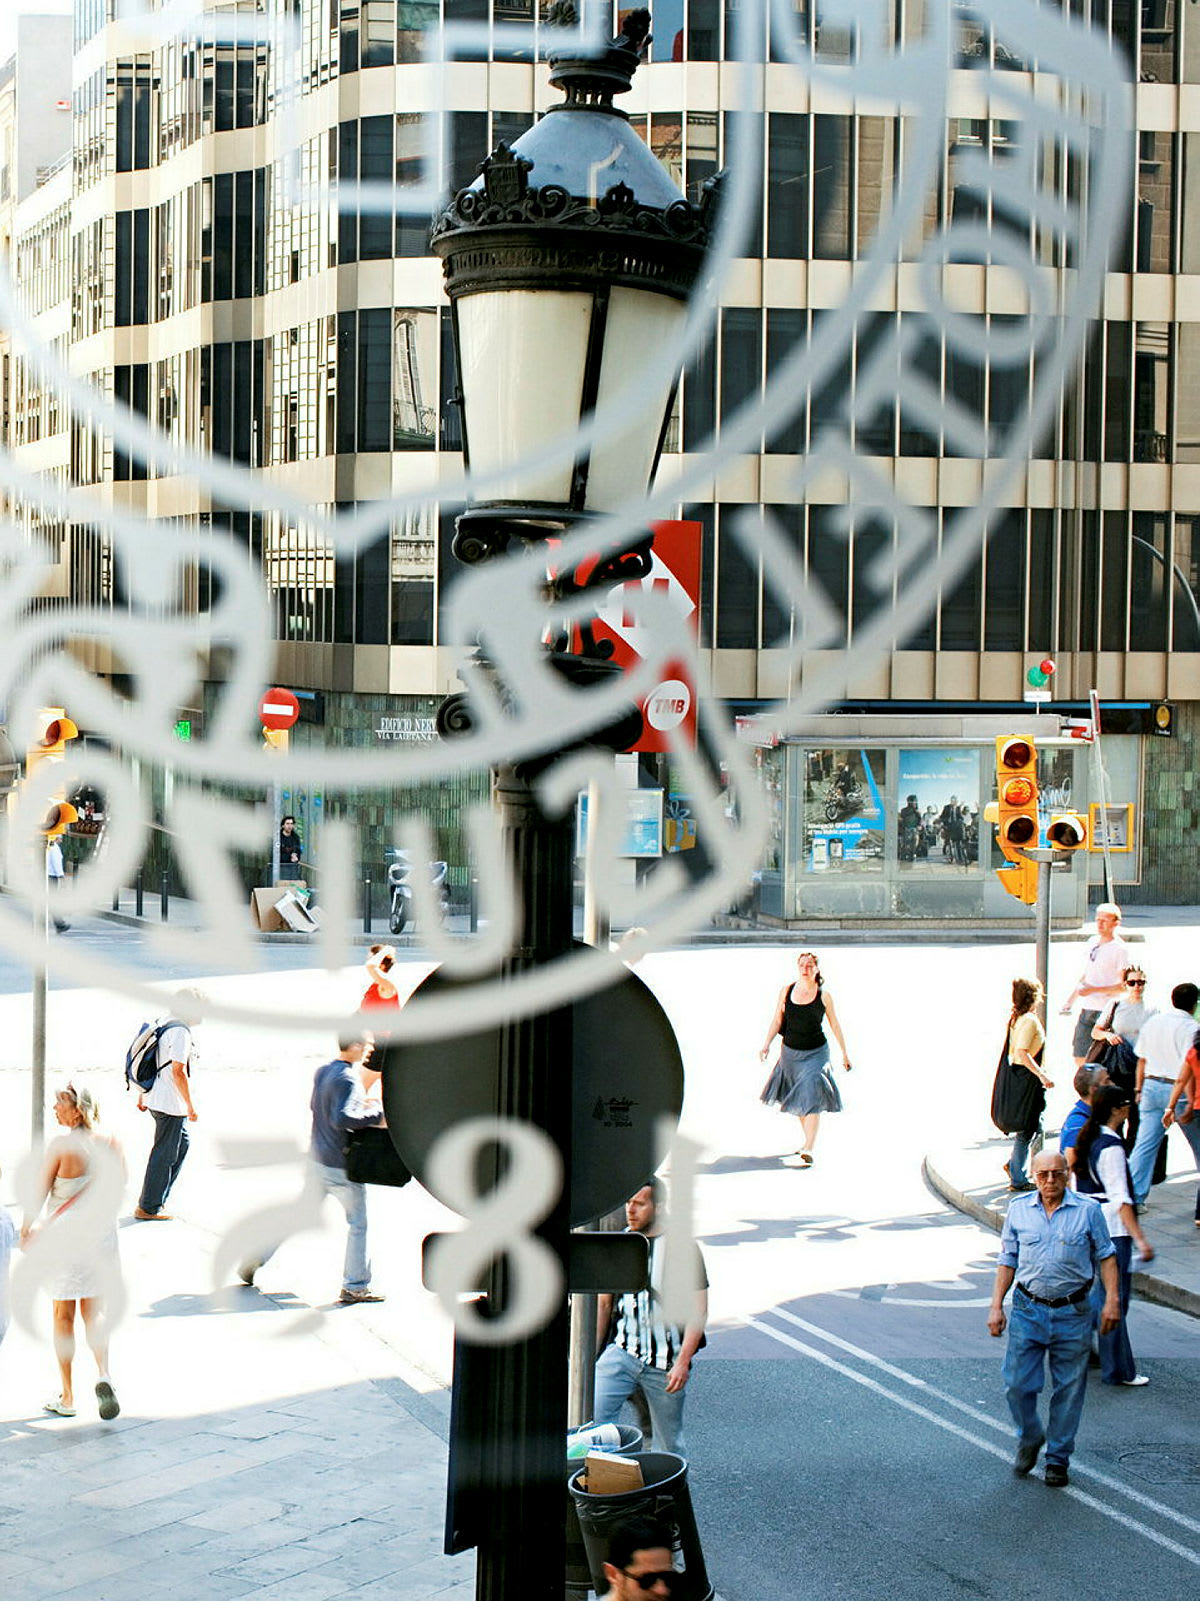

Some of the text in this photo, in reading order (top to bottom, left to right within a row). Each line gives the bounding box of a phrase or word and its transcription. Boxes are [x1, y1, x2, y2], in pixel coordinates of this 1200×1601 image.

[654, 698, 686, 714] TMB
[381, 718, 438, 731] EDIFICIO NERV
[377, 731, 391, 740] VIA
